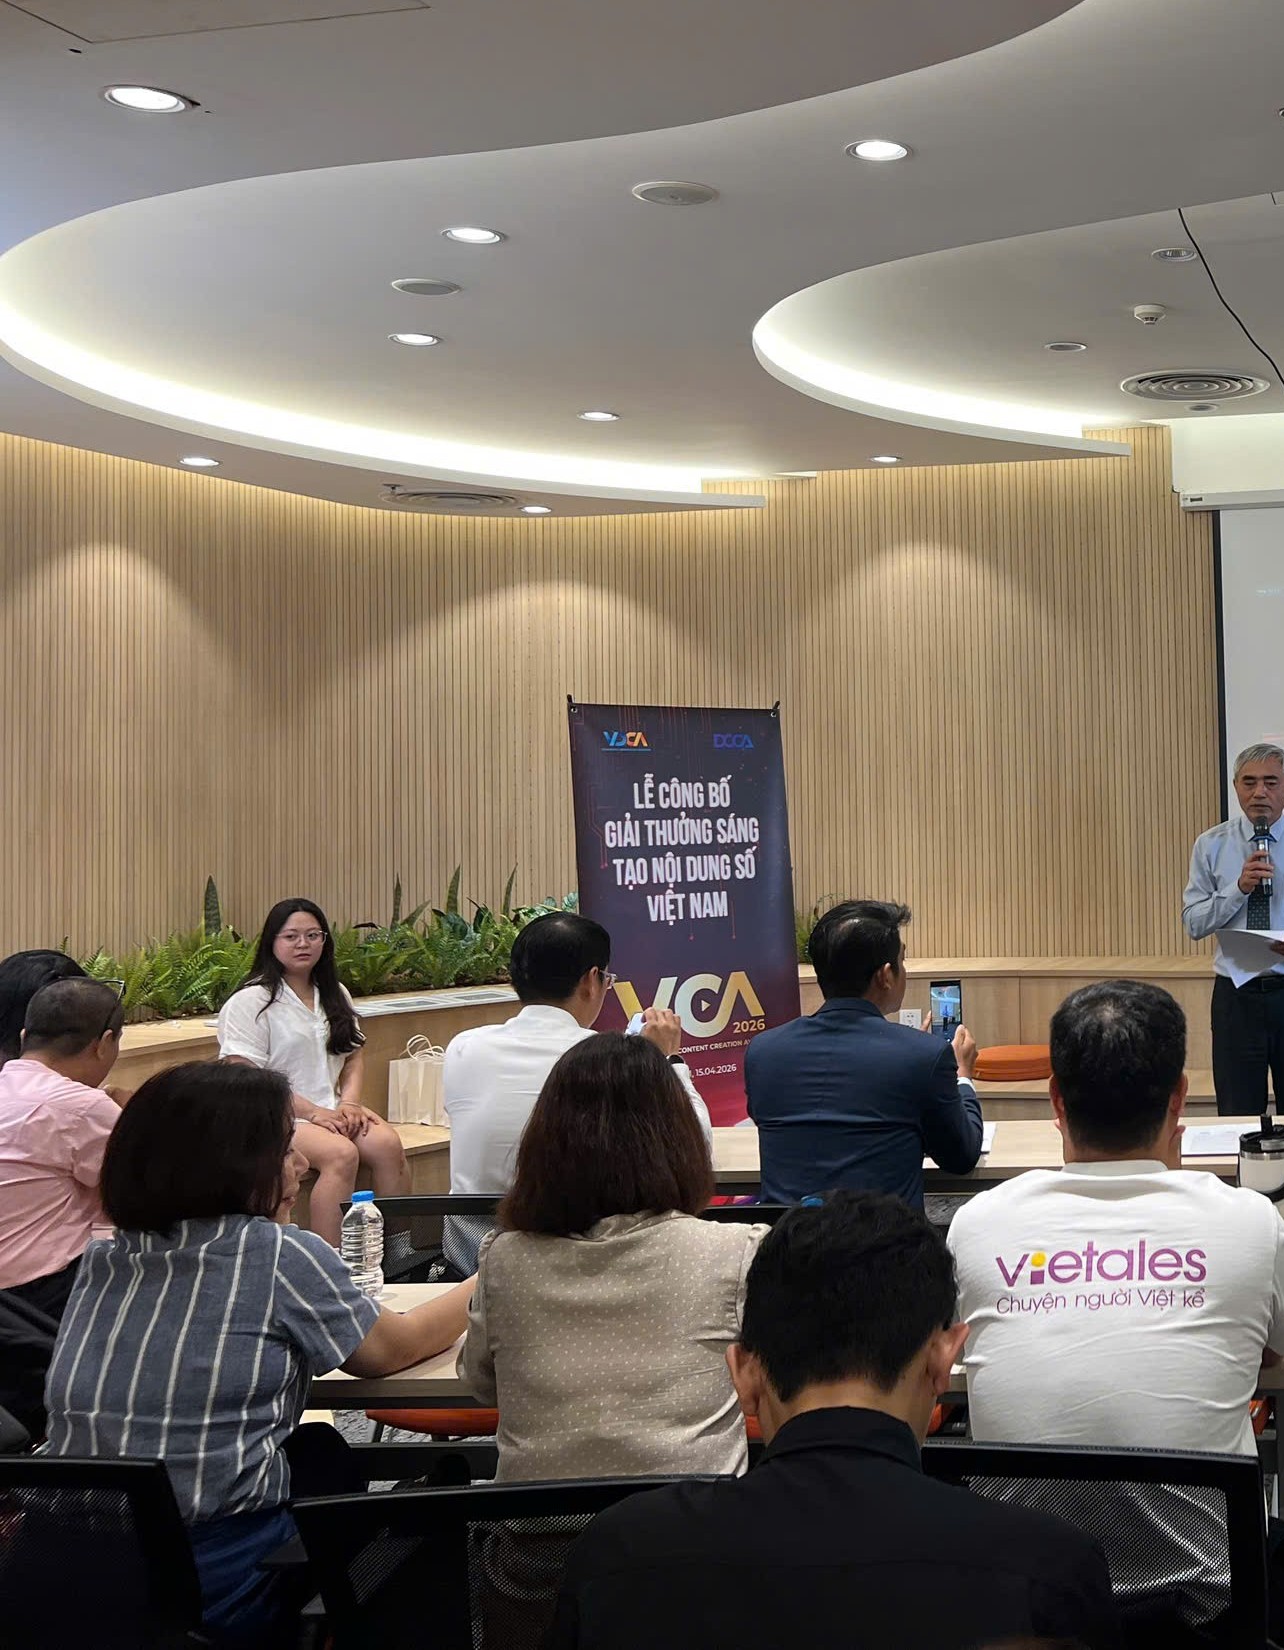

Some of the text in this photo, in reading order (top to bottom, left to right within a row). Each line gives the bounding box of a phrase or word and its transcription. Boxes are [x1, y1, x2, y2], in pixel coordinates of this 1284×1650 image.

[633, 773, 732, 809] LỄ CÔNG BỐ
[604, 812, 640, 848] GIẢI
[716, 812, 760, 844] SÁNG
[613, 845, 758, 890] TẠO NỘI DUNG SỐ
[647, 888, 729, 926] VIỆT NAM
[709, 1039, 742, 1050] CREATION
[733, 1019, 766, 1034] 2026
[695, 1063, 737, 1077] 15.04.2026
[995, 1239, 1207, 1288] vietales
[996, 1287, 1206, 1315] Chuyện người Việt kể
